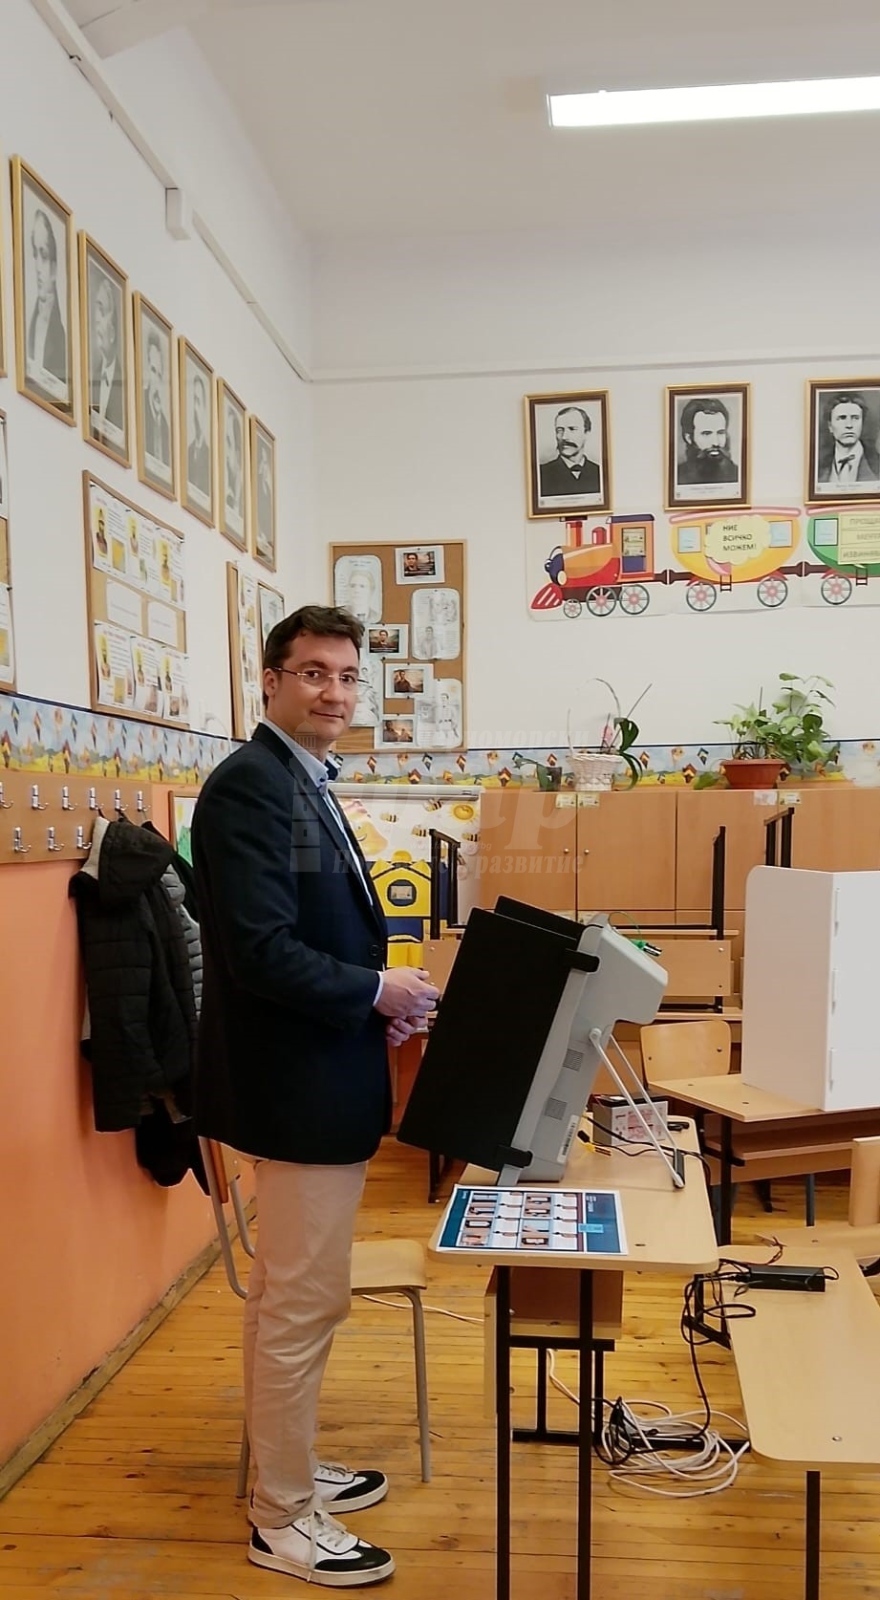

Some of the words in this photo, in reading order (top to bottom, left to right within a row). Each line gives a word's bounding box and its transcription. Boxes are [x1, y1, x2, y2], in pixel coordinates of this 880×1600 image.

[723, 524, 738, 532] НИЕ
[722, 533, 753, 542] ВСИЧКО
[722, 543, 757, 552] МОЖЕМ!
